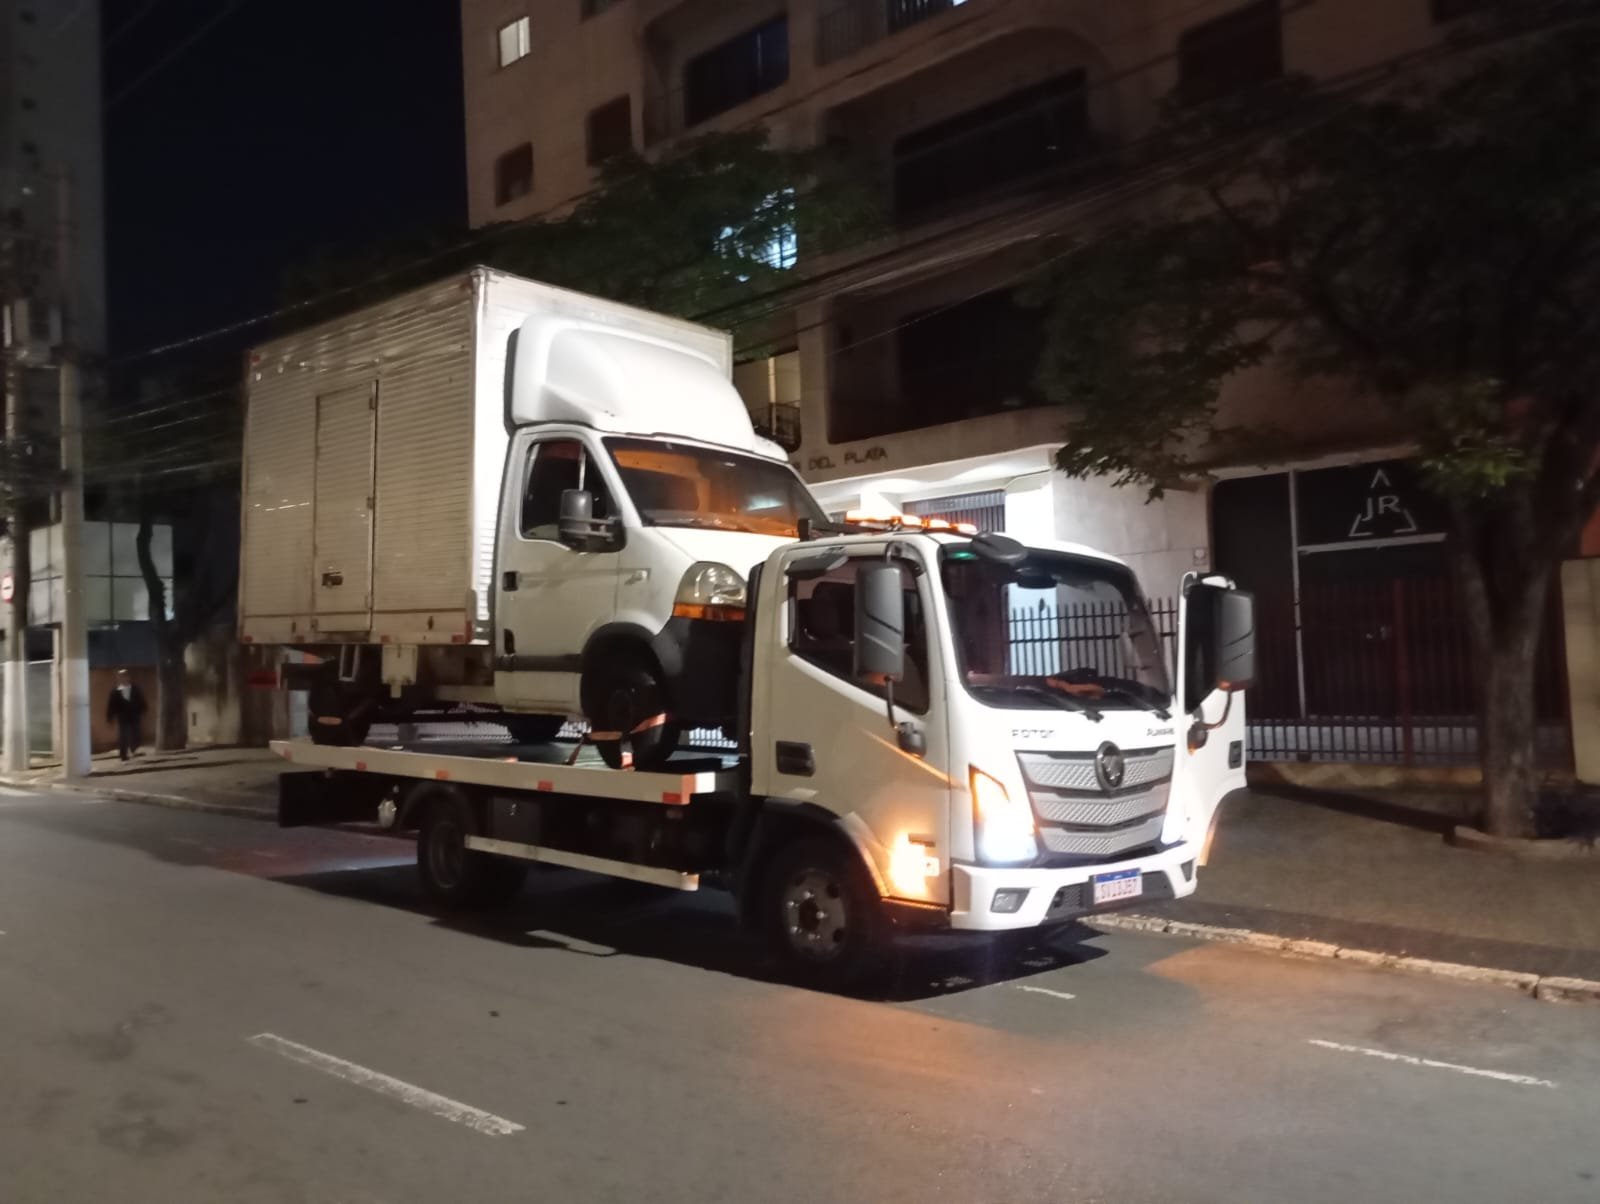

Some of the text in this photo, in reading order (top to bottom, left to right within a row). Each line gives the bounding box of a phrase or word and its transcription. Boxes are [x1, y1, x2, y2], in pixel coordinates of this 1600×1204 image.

[808, 456, 836, 471] DEL
[844, 446, 888, 465] PLATA
[1361, 495, 1401, 522] JR
